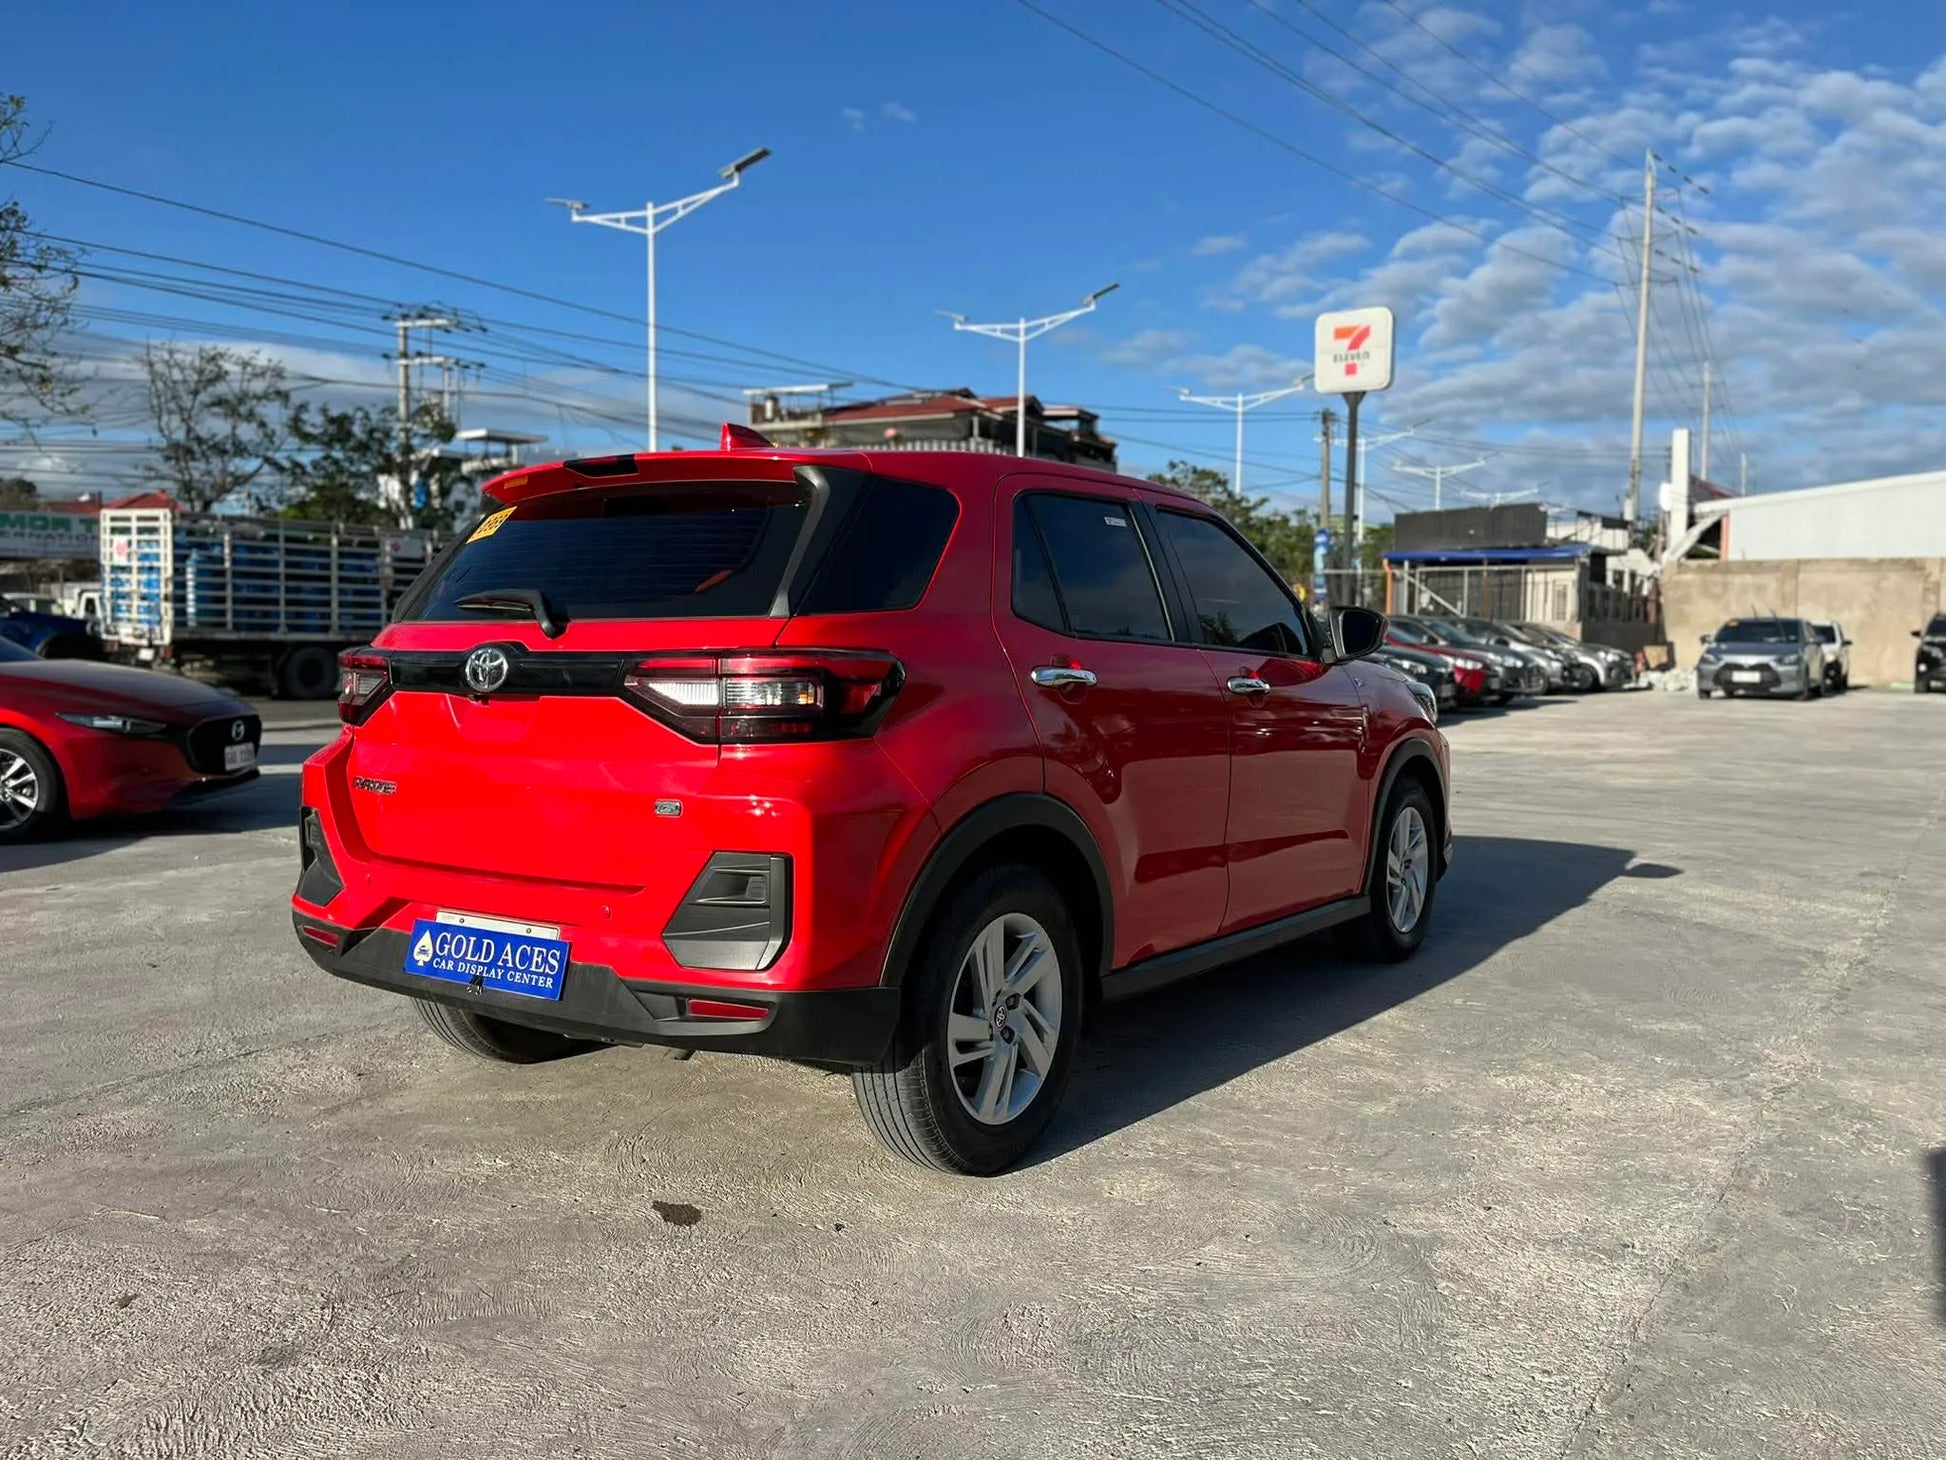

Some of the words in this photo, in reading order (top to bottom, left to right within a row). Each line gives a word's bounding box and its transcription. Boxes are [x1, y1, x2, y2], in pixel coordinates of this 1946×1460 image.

[1333, 325, 1370, 375] 7
[432, 957, 454, 972] CAR
[457, 962, 505, 979] DISPLAY
[506, 970, 553, 989] CENTER
[435, 932, 495, 964] GOLD
[497, 942, 561, 975] ACES
